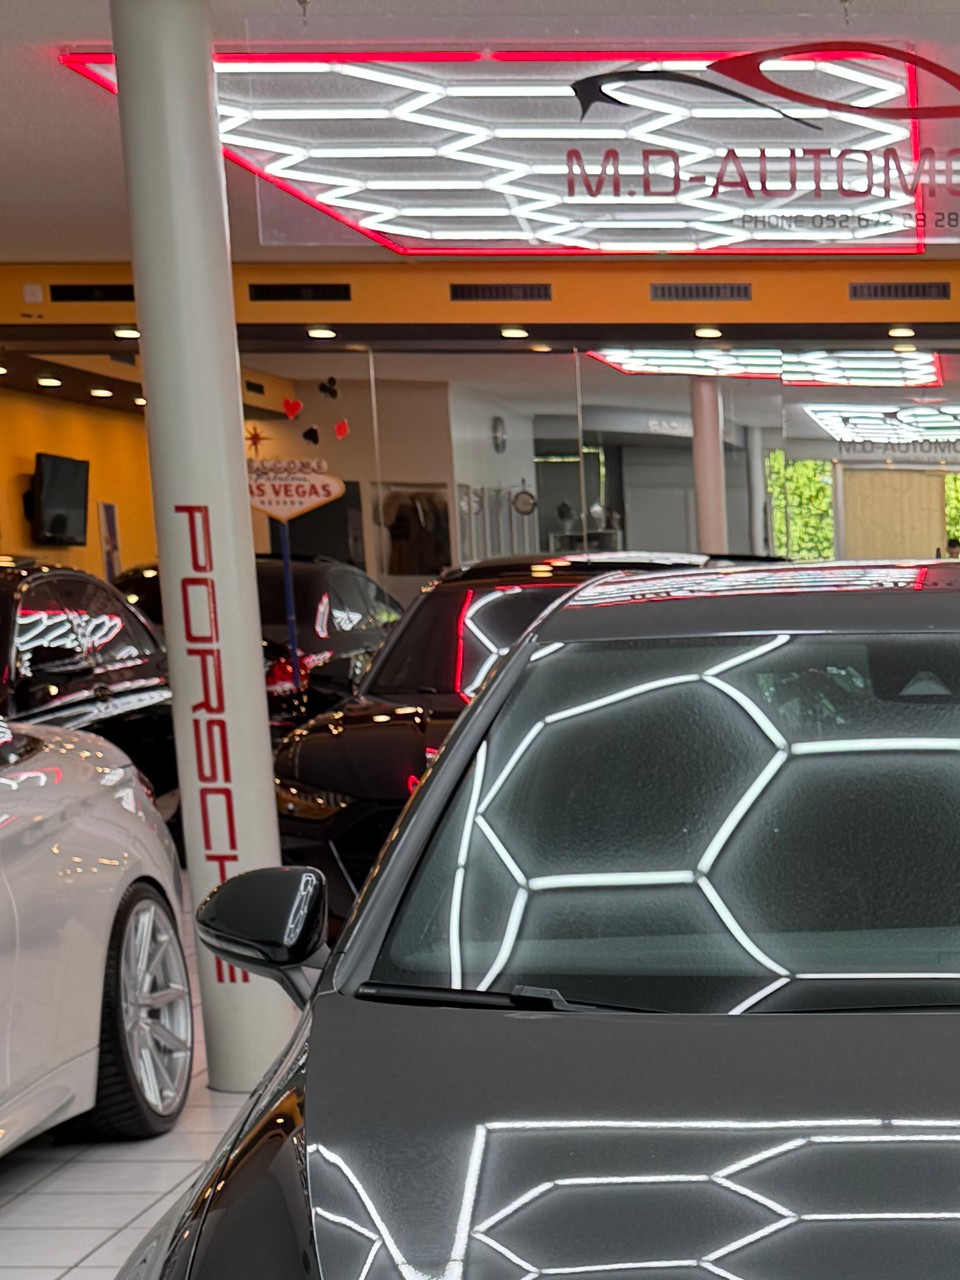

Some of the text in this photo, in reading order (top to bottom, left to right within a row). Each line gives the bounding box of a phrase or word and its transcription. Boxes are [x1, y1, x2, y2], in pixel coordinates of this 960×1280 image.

[741, 212, 960, 228] PHONE 052 672 28 28
[271, 484, 332, 498] VEGAS
